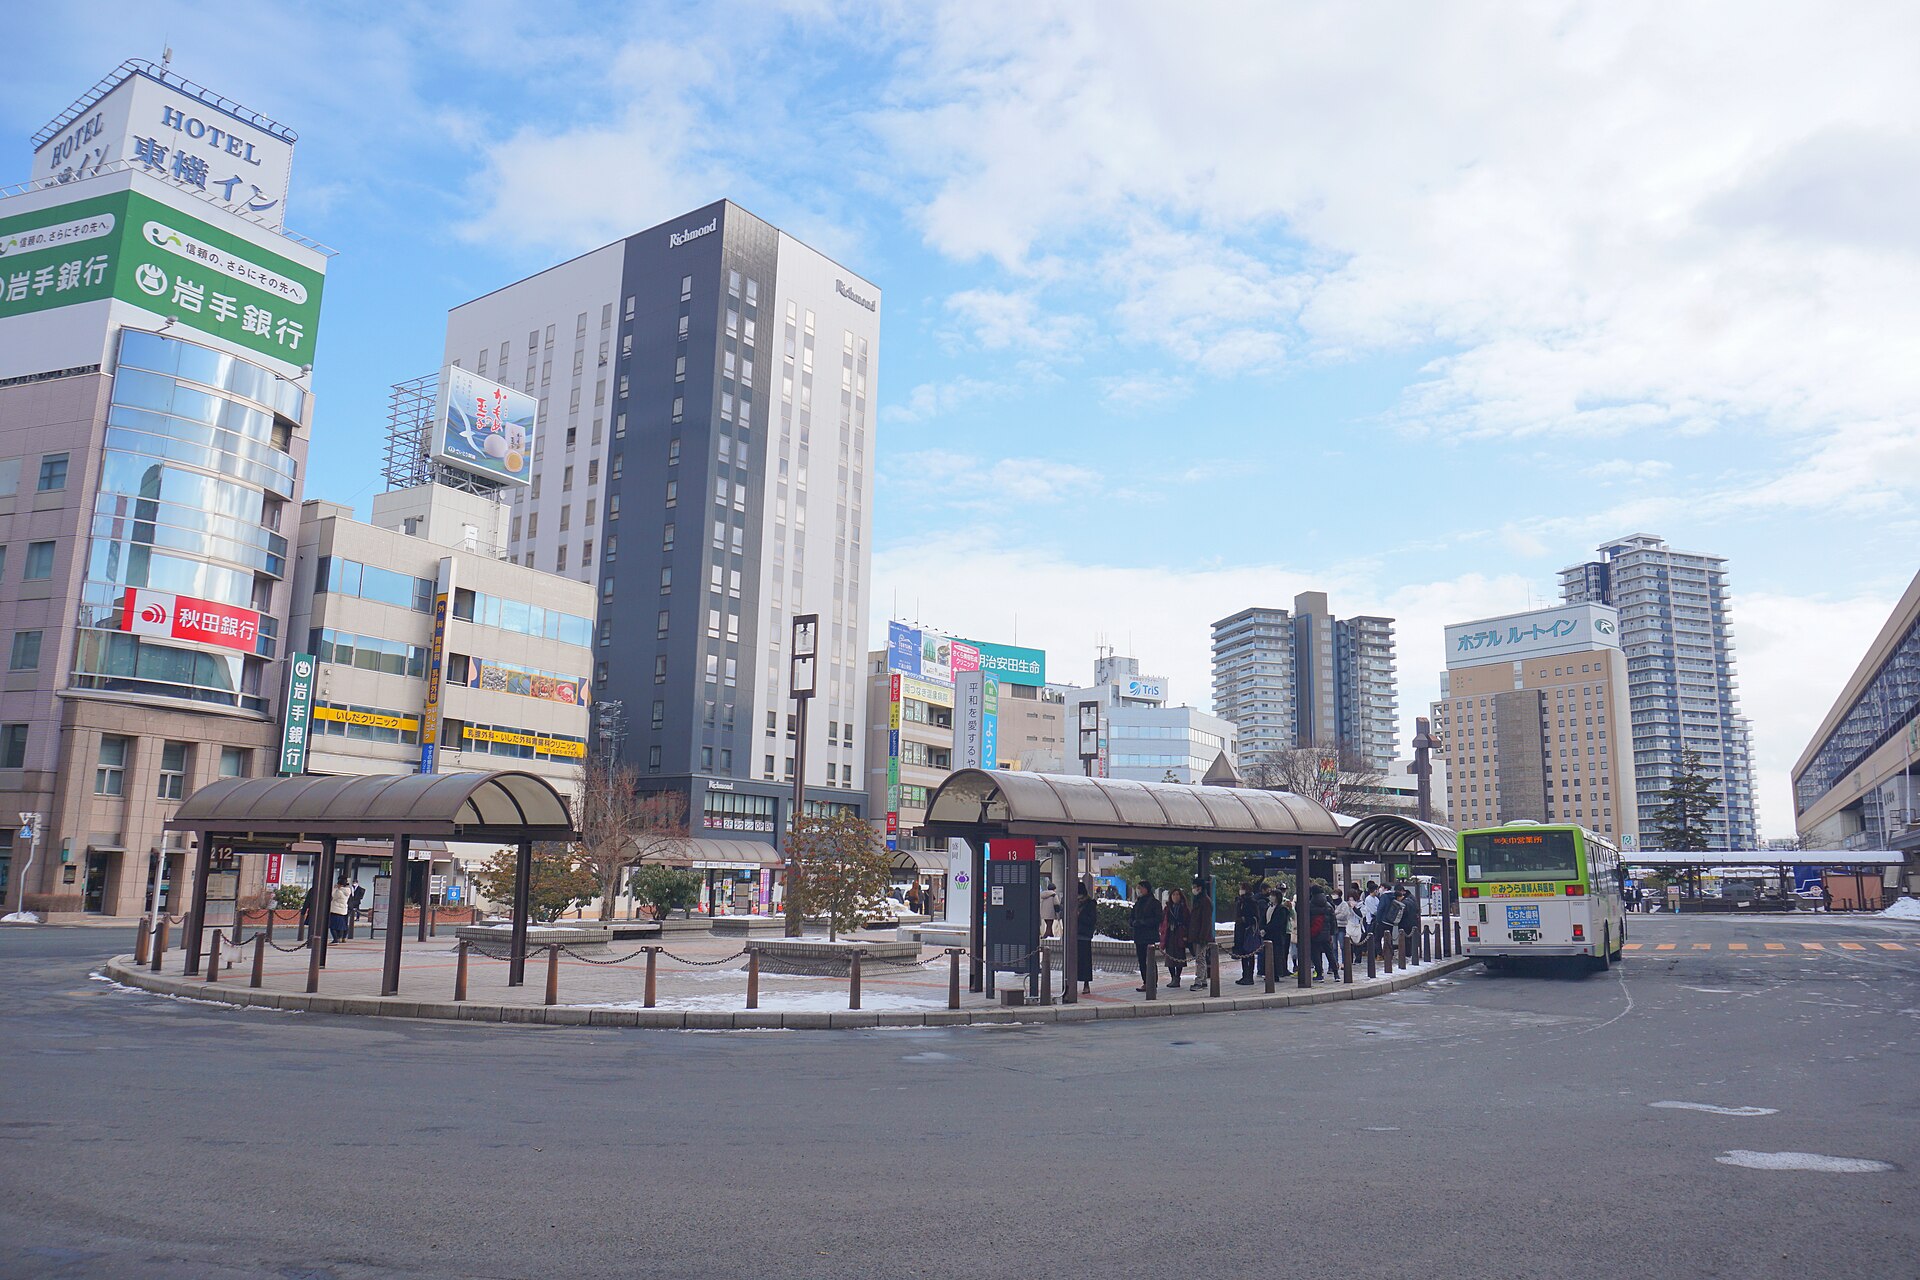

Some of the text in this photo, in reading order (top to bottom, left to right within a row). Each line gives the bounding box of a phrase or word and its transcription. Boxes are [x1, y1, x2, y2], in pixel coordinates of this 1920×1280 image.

[50, 112, 104, 170] HOTEL
[161, 104, 263, 167] HOTEL
[129, 134, 279, 212] 東横イン
[19, 220, 110, 249] 信頼の、さらにその先へ。
[669, 217, 718, 249] Richmond
[5, 254, 109, 303] 岩手銀行
[185, 242, 303, 301] 信頼の、さらにその先へ。
[835, 278, 876, 313] Richmond
[171, 275, 304, 351] 岩手銀行
[179, 607, 255, 641] 秋田銀行
[1457, 619, 1578, 652] ホテル ルートイン
[1142, 684, 1160, 695] TriS
[285, 681, 308, 767] 岩手銀行
[336, 711, 399, 727] いしだクリニック
[708, 780, 734, 790] Richmond
[218, 847, 232, 859] 12
[270, 855, 279, 881] 秋田銀行
[1008, 850, 1017, 860] 13
[1395, 866, 1407, 876] 14
[1527, 933, 1537, 941] 54
